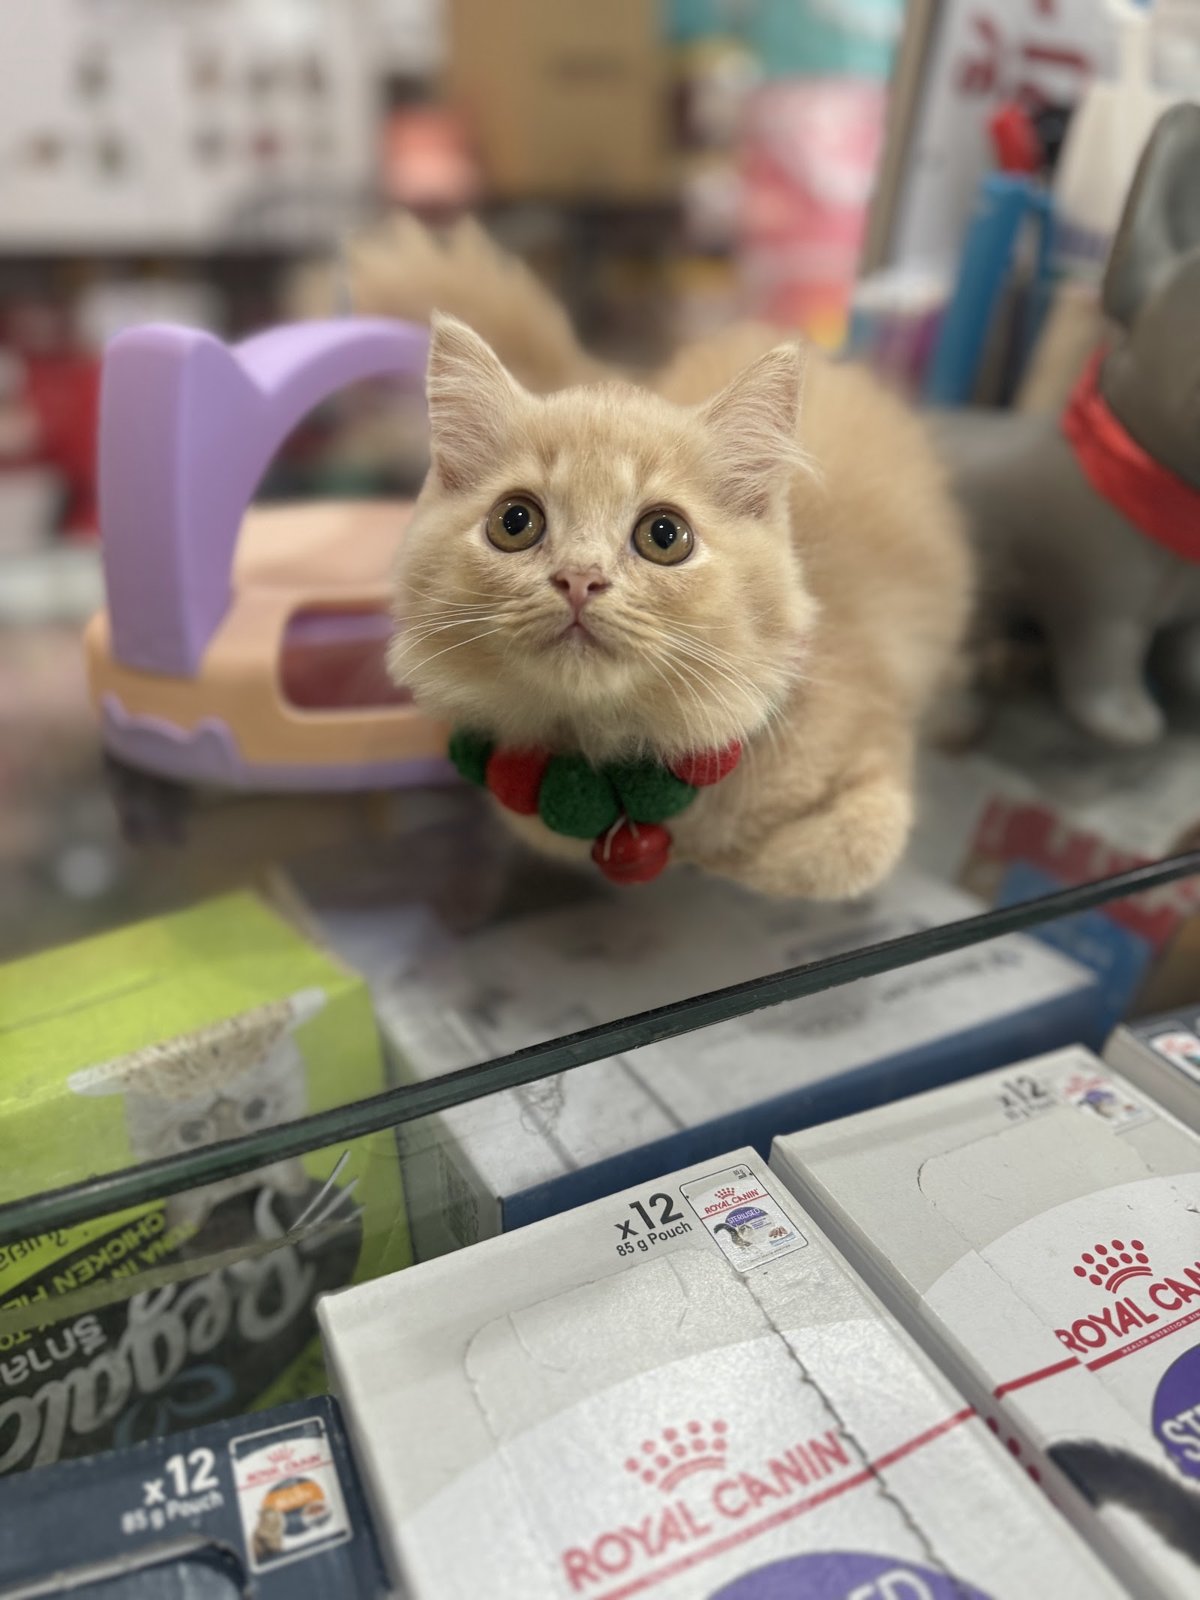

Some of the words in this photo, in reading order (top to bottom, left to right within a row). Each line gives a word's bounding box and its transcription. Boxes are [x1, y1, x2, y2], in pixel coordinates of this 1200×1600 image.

[614, 1193, 684, 1240] x12
[704, 1199, 732, 1215] ROYAL
[732, 1189, 760, 1204] CANIN
[52, 1212, 165, 1295] CHICKEN
[616, 1241, 635, 1256] 85
[637, 1240, 648, 1251] g
[647, 1221, 693, 1245] Pouch
[1054, 1297, 1159, 1354] ROYAL
[143, 1447, 219, 1507] x12
[561, 1499, 712, 1592] ROYAL
[711, 1429, 851, 1519] CANIN
